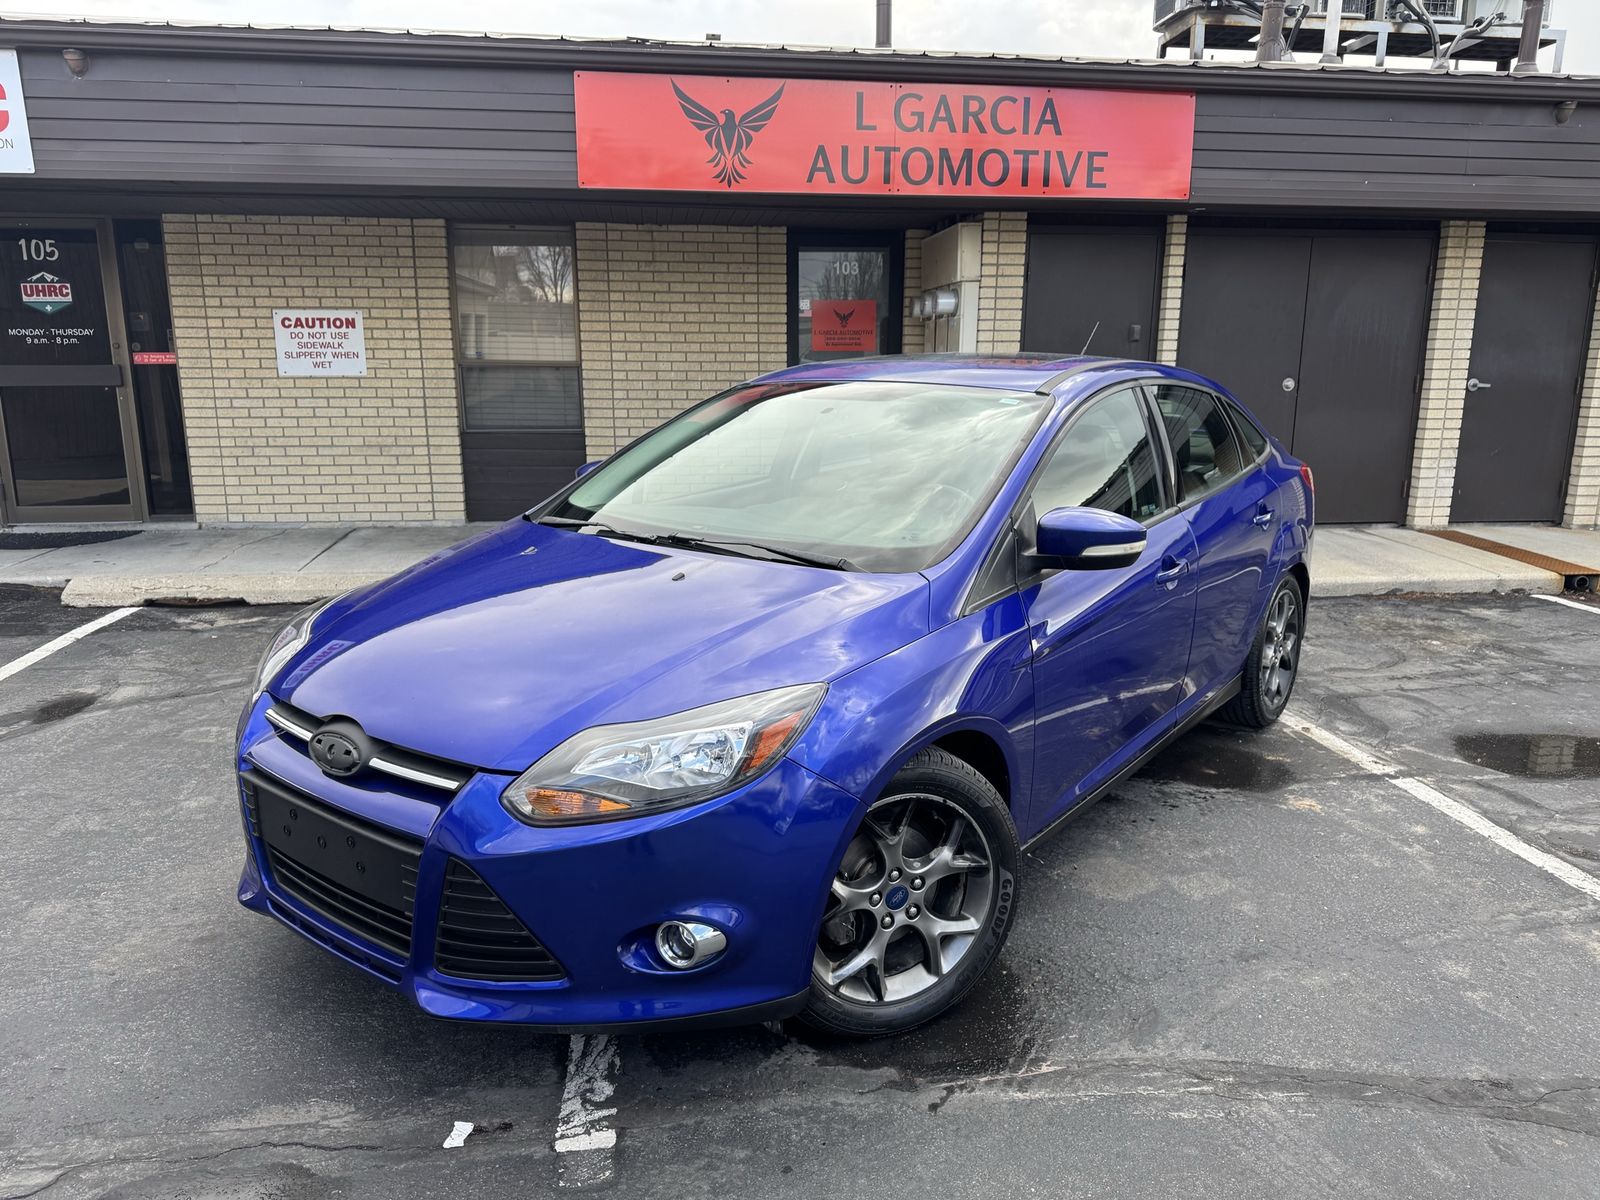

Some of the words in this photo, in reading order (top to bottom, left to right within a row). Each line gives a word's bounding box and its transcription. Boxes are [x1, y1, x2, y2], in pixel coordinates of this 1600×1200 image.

[855, 91, 878, 131] L
[893, 92, 1063, 136] GARCIA
[805, 144, 1109, 189] AUTOMOTIVE
[18, 238, 59, 261] 105
[833, 261, 859, 275] 103
[22, 284, 70, 298] UHRC
[280, 317, 356, 329] CAUTION
[8, 328, 45, 336] MONDAY
[50, 328, 95, 336] THURSDAY
[290, 331, 305, 340] DO
[307, 331, 327, 340] NOT
[330, 331, 350, 340] USE
[297, 341, 344, 350] SIDEWALK
[284, 351, 328, 359] SLIPPERY
[330, 351, 359, 359] WHEN
[312, 361, 333, 369] WET
